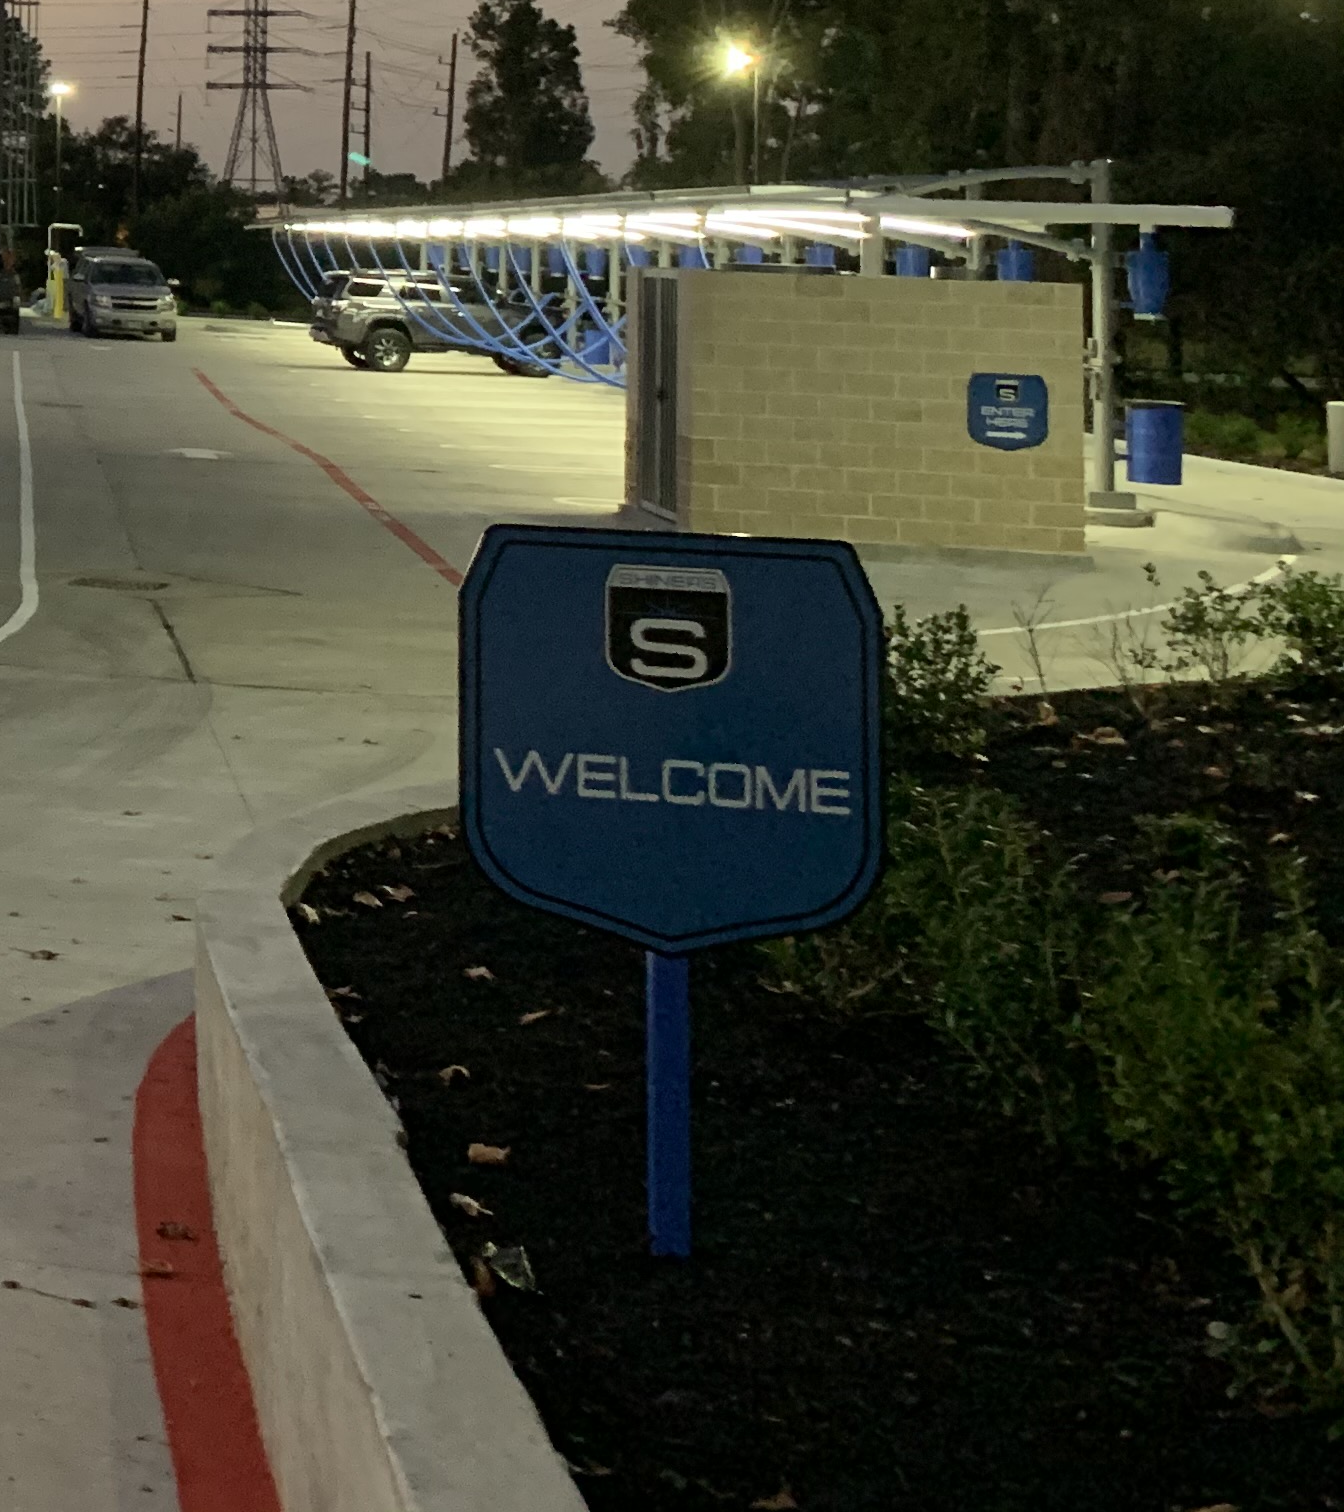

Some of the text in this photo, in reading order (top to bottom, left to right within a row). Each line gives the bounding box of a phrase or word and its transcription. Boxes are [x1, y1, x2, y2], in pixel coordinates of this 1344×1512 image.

[981, 406, 1035, 418] ENTER
[999, 388, 1016, 401] S
[630, 618, 708, 678] S
[494, 748, 851, 815] WELCOME
